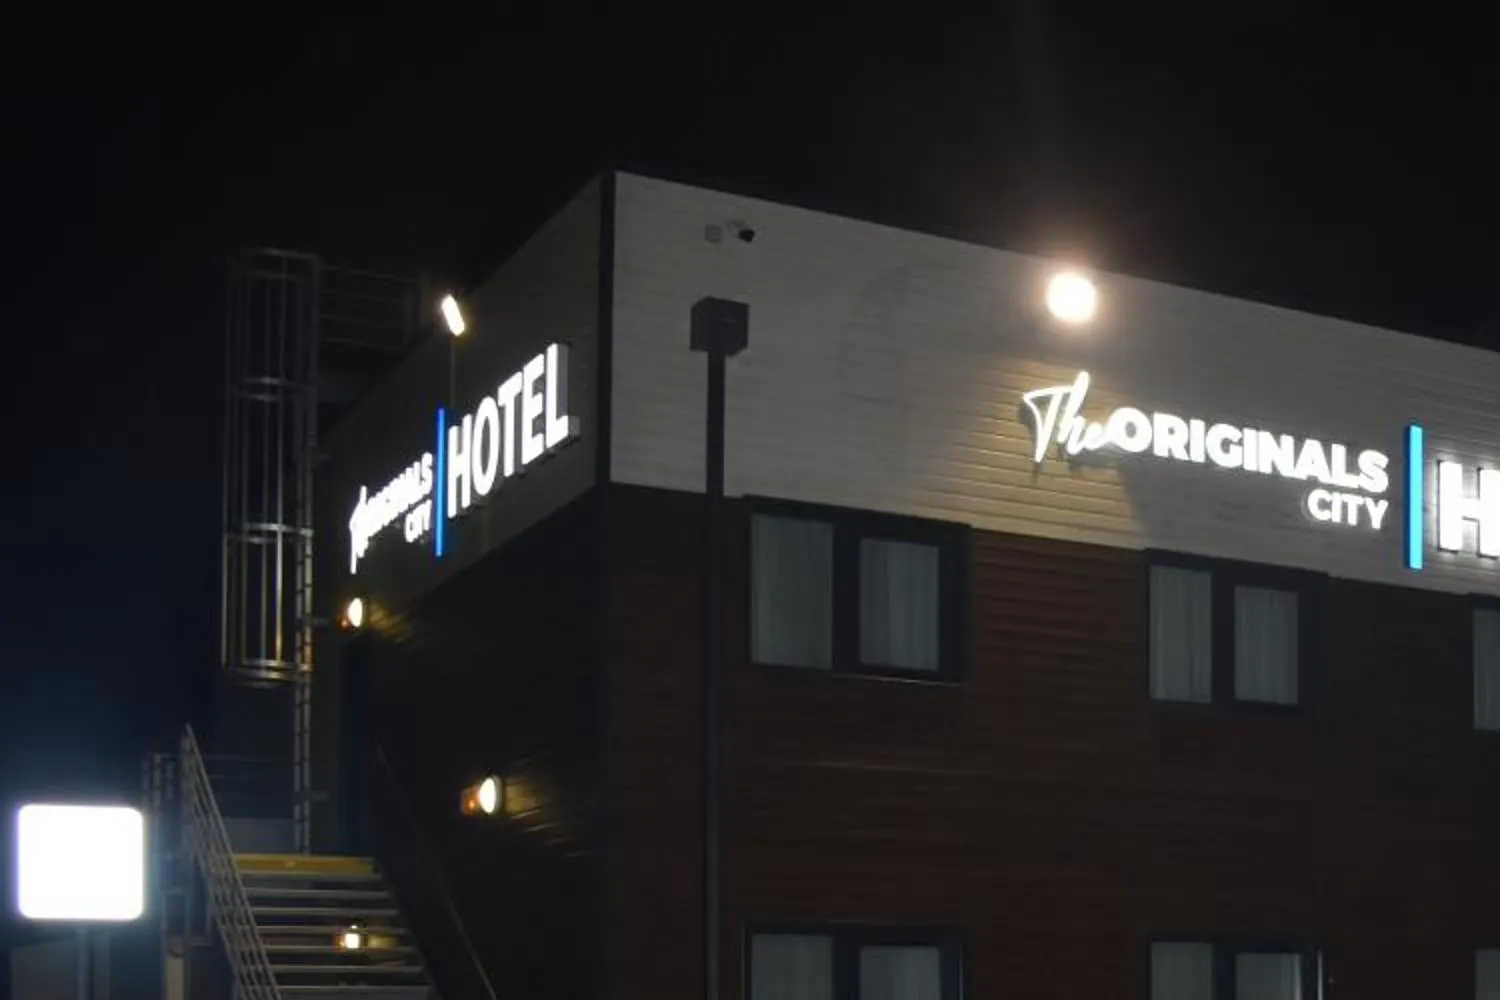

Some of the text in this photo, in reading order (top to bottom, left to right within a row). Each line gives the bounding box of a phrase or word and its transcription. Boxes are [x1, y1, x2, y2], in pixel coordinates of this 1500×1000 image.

[448, 343, 569, 519] HOTEL
[1023, 371, 1389, 493] The ORIGINALS
[1307, 488, 1389, 529] CITY
